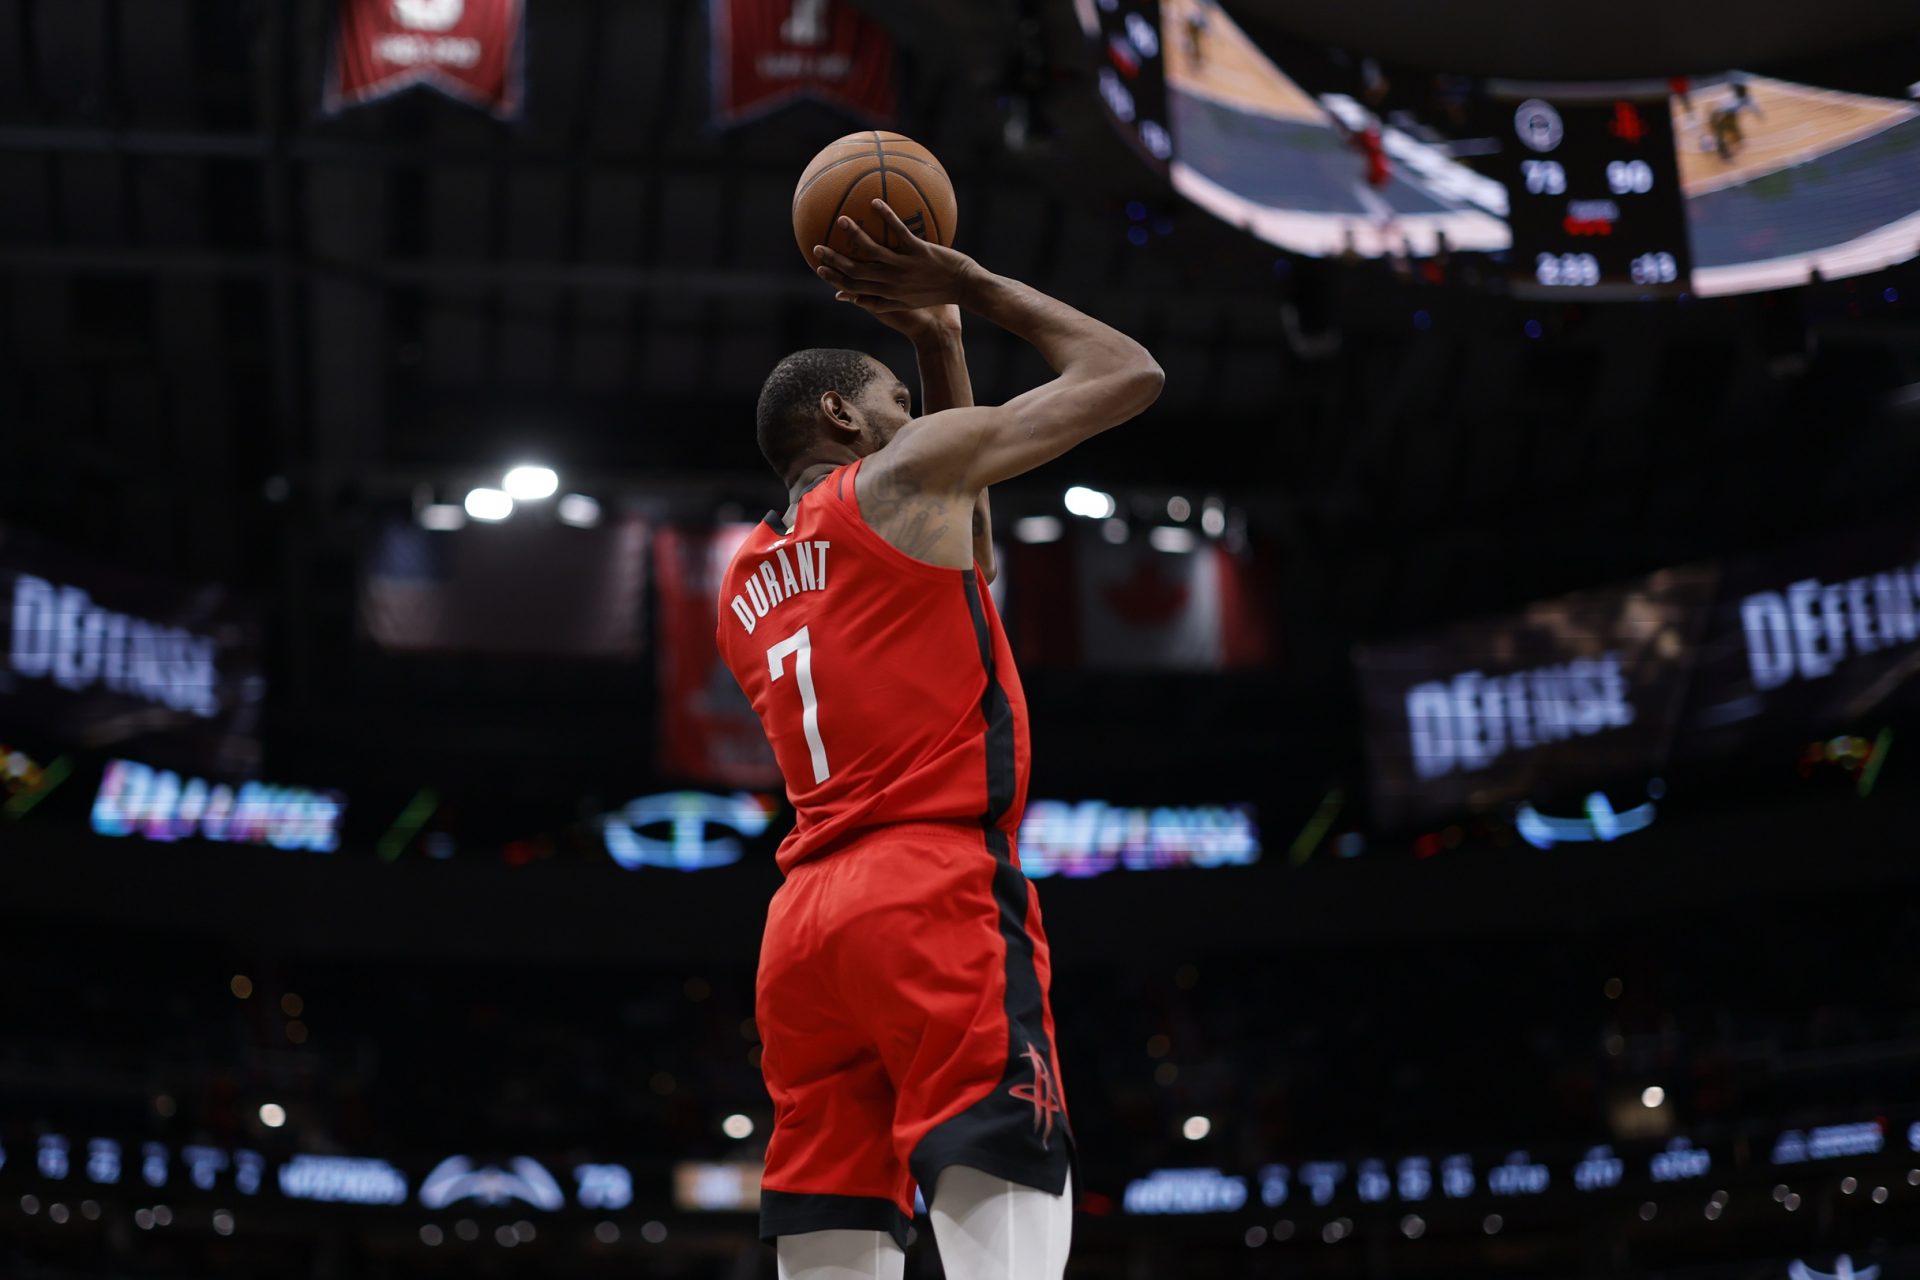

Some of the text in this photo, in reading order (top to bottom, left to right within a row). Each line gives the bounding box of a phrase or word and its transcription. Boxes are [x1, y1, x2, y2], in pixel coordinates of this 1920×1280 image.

[731, 540, 830, 635] DURANT
[1739, 563, 1920, 689] DEFEN
[766, 625, 830, 785] 7
[1406, 654, 1634, 778] DEFENSE
